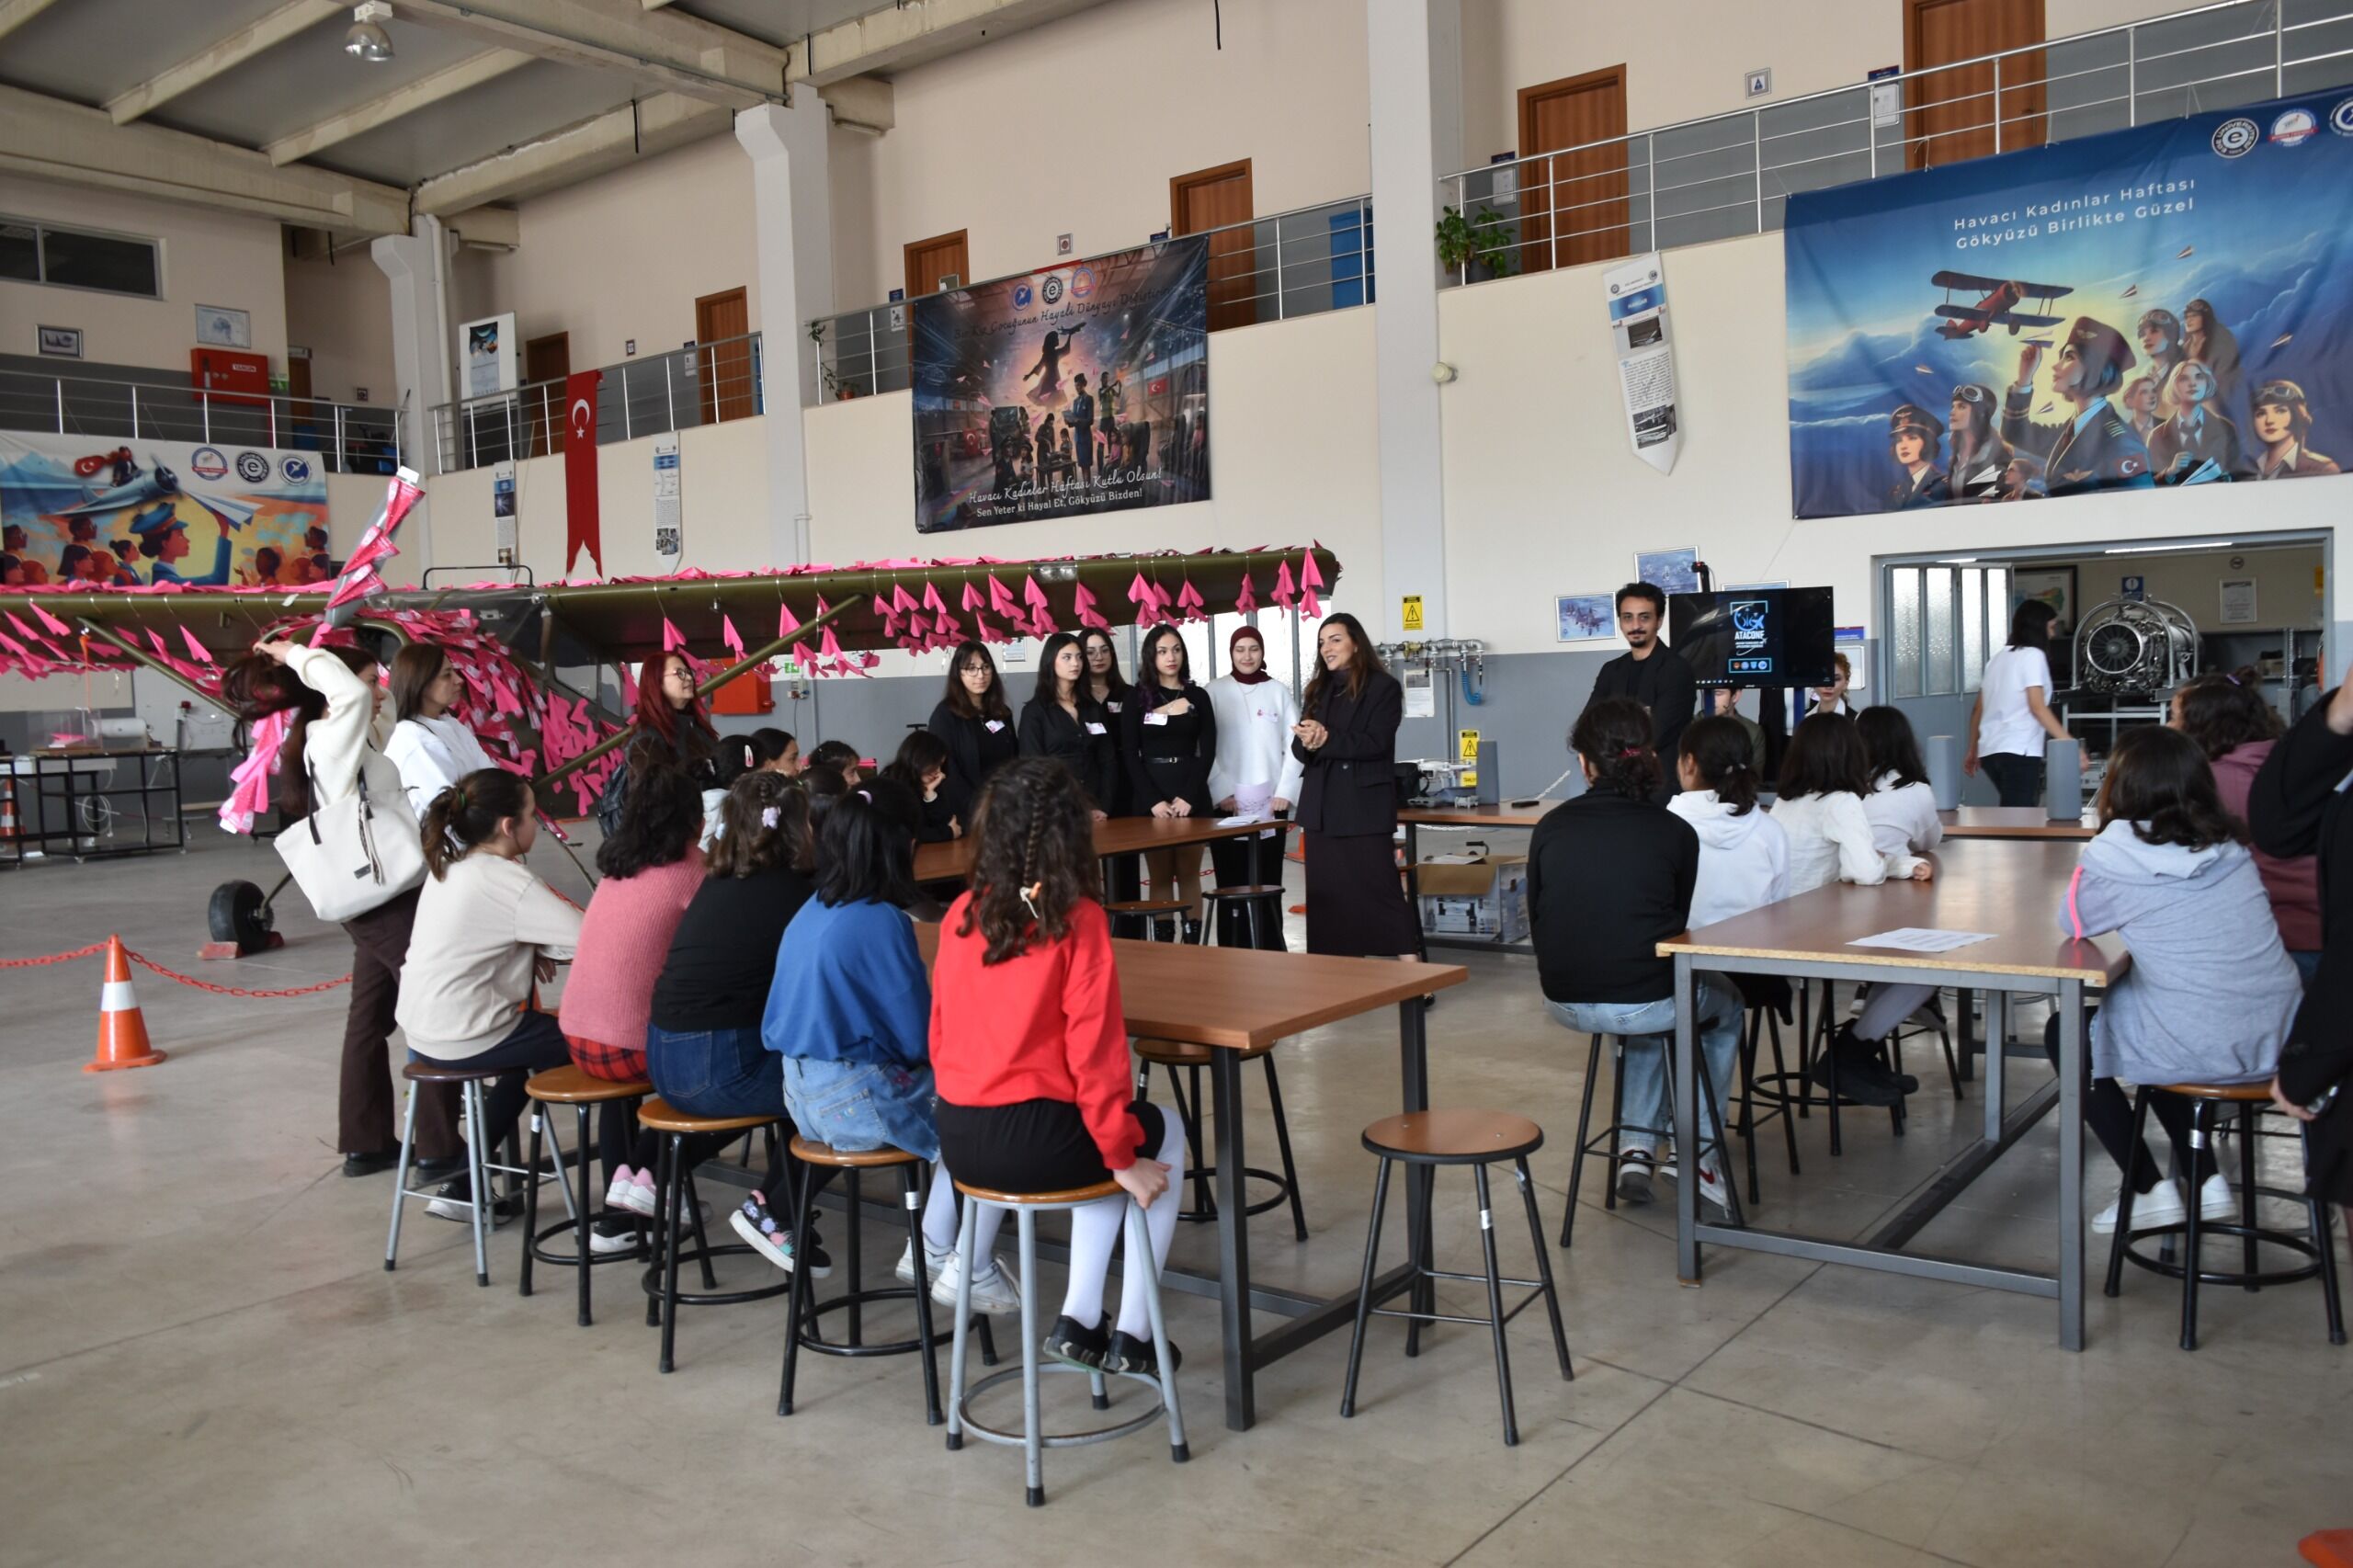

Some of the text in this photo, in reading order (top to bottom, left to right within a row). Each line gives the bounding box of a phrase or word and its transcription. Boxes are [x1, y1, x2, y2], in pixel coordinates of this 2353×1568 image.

[1954, 179, 2195, 231] Havacı Kadınlar Haftası
[1956, 198, 2193, 249] Gökyüzü Birlikte Güzel
[1040, 301, 1074, 325] Hayali
[1077, 300, 1116, 317] Dünyayı
[969, 466, 1163, 505] Havacı Kadınlar Haftası Kutlu Olsun!
[977, 507, 993, 517] Sen
[994, 506, 1016, 516] Yeter
[1028, 501, 1051, 512] Hayal
[1053, 499, 1066, 509] Et,
[1068, 492, 1106, 506] Gökyüzü
[1108, 488, 1142, 501] Bizden!
